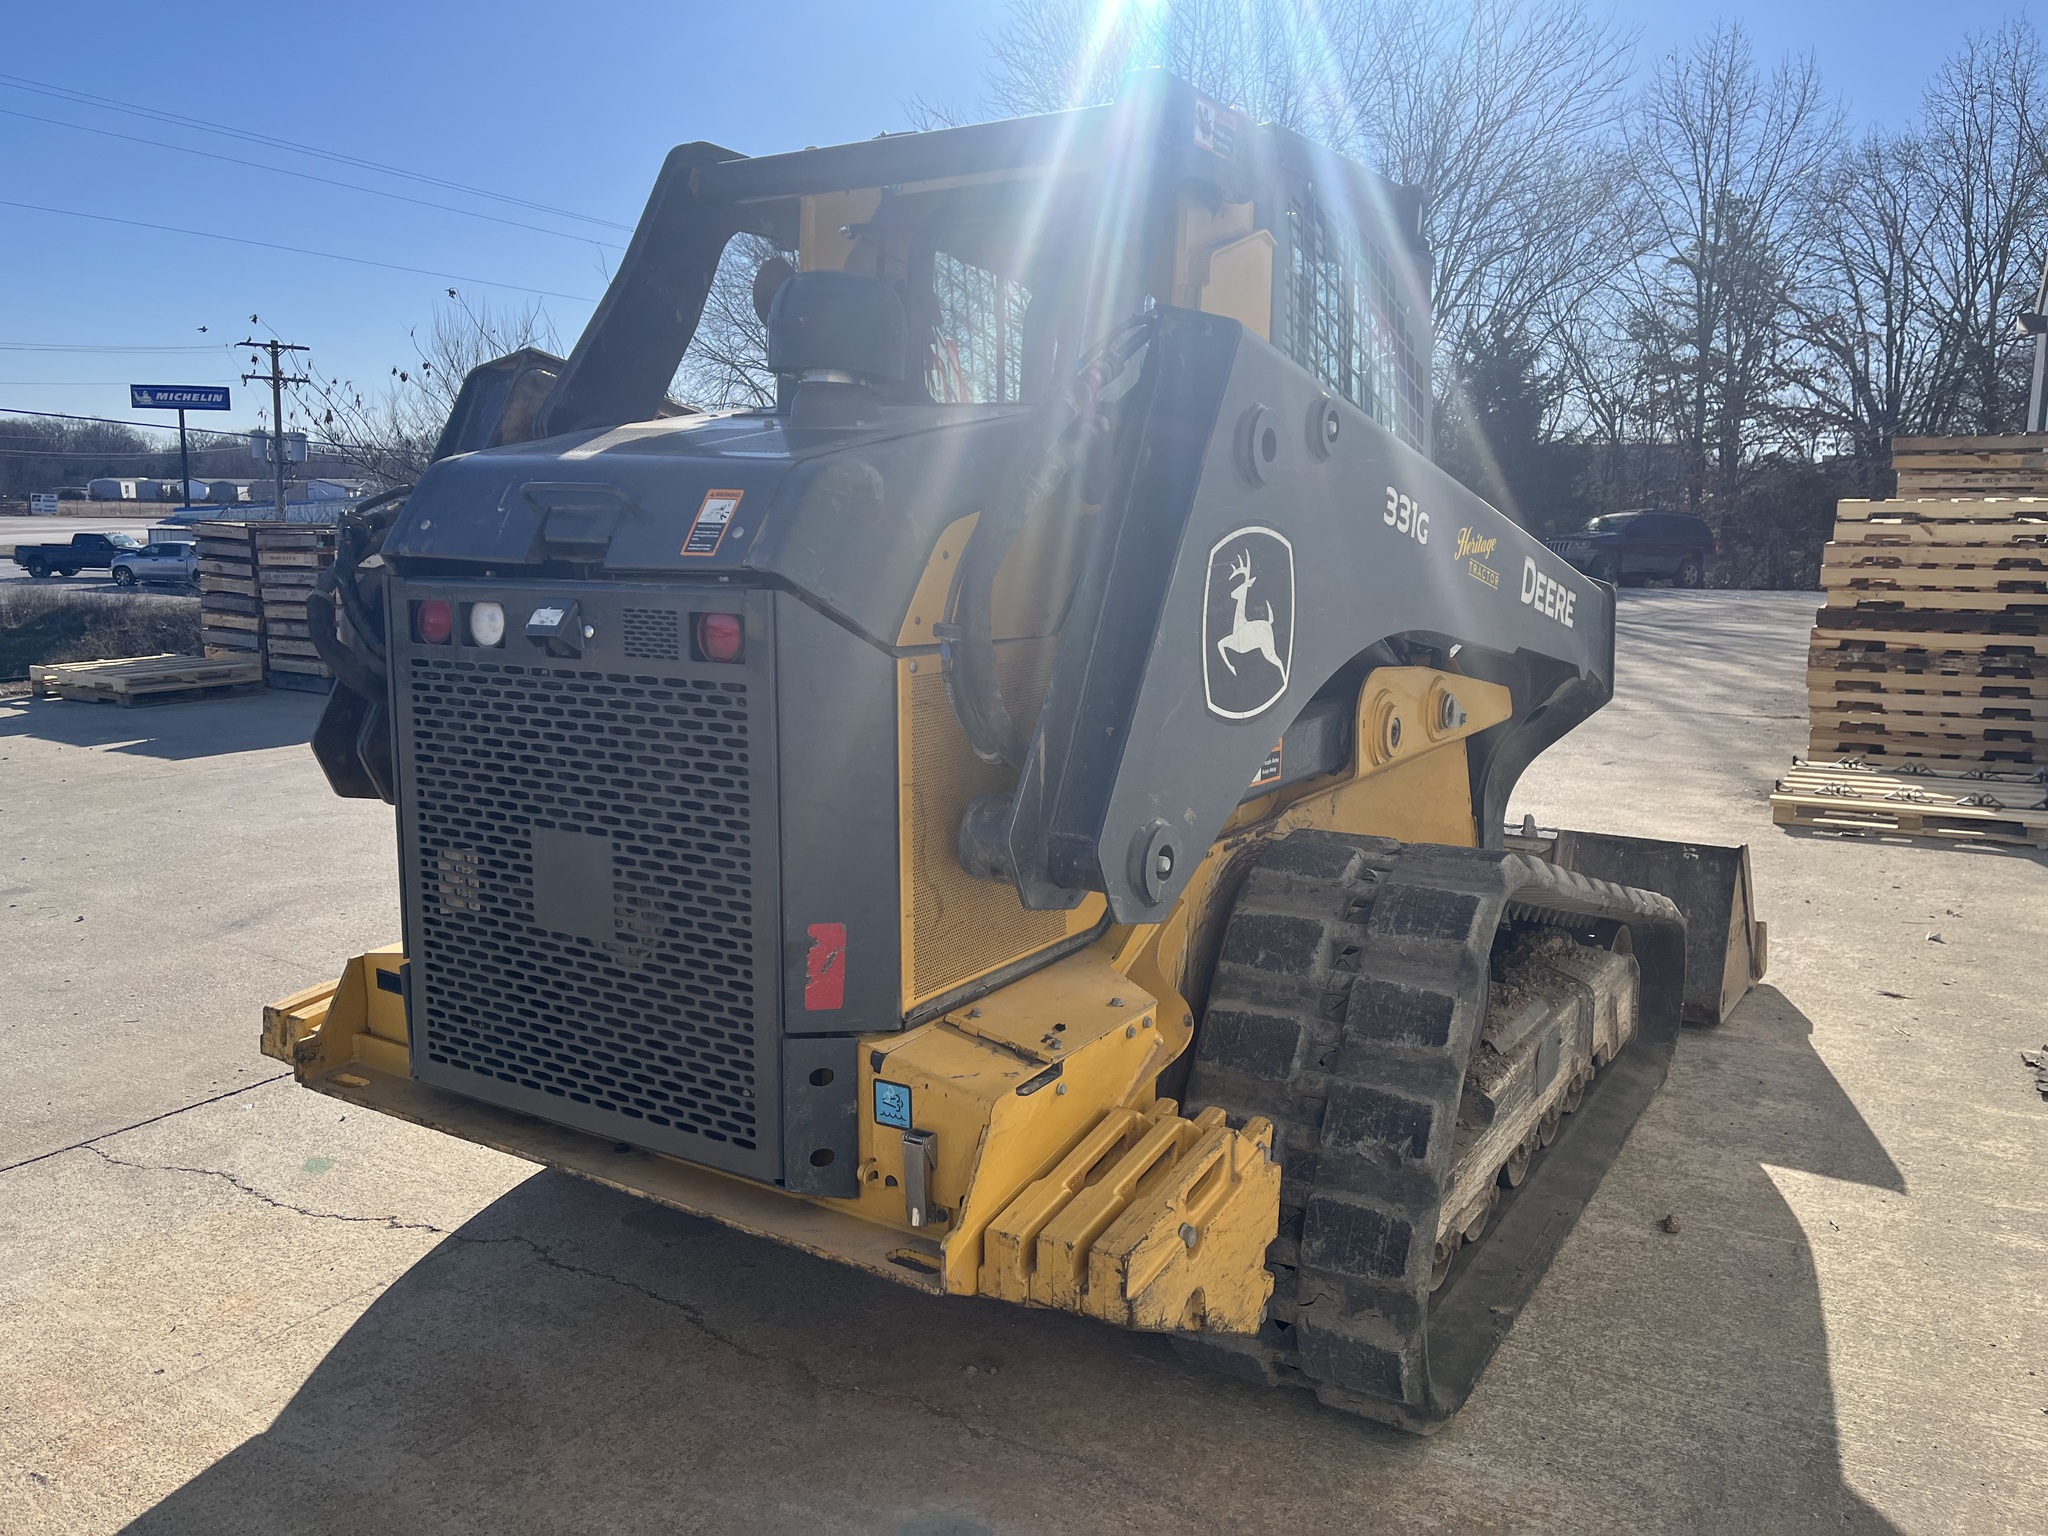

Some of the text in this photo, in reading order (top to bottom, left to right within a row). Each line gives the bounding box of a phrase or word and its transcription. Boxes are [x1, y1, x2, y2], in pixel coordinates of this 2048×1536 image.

[156, 392, 223, 402] MICHELIN
[1383, 486, 1430, 545] 331G
[1454, 526, 1497, 560] Heritage
[1469, 561, 1500, 587] TRACTOR
[1520, 555, 1577, 629] DEERE
